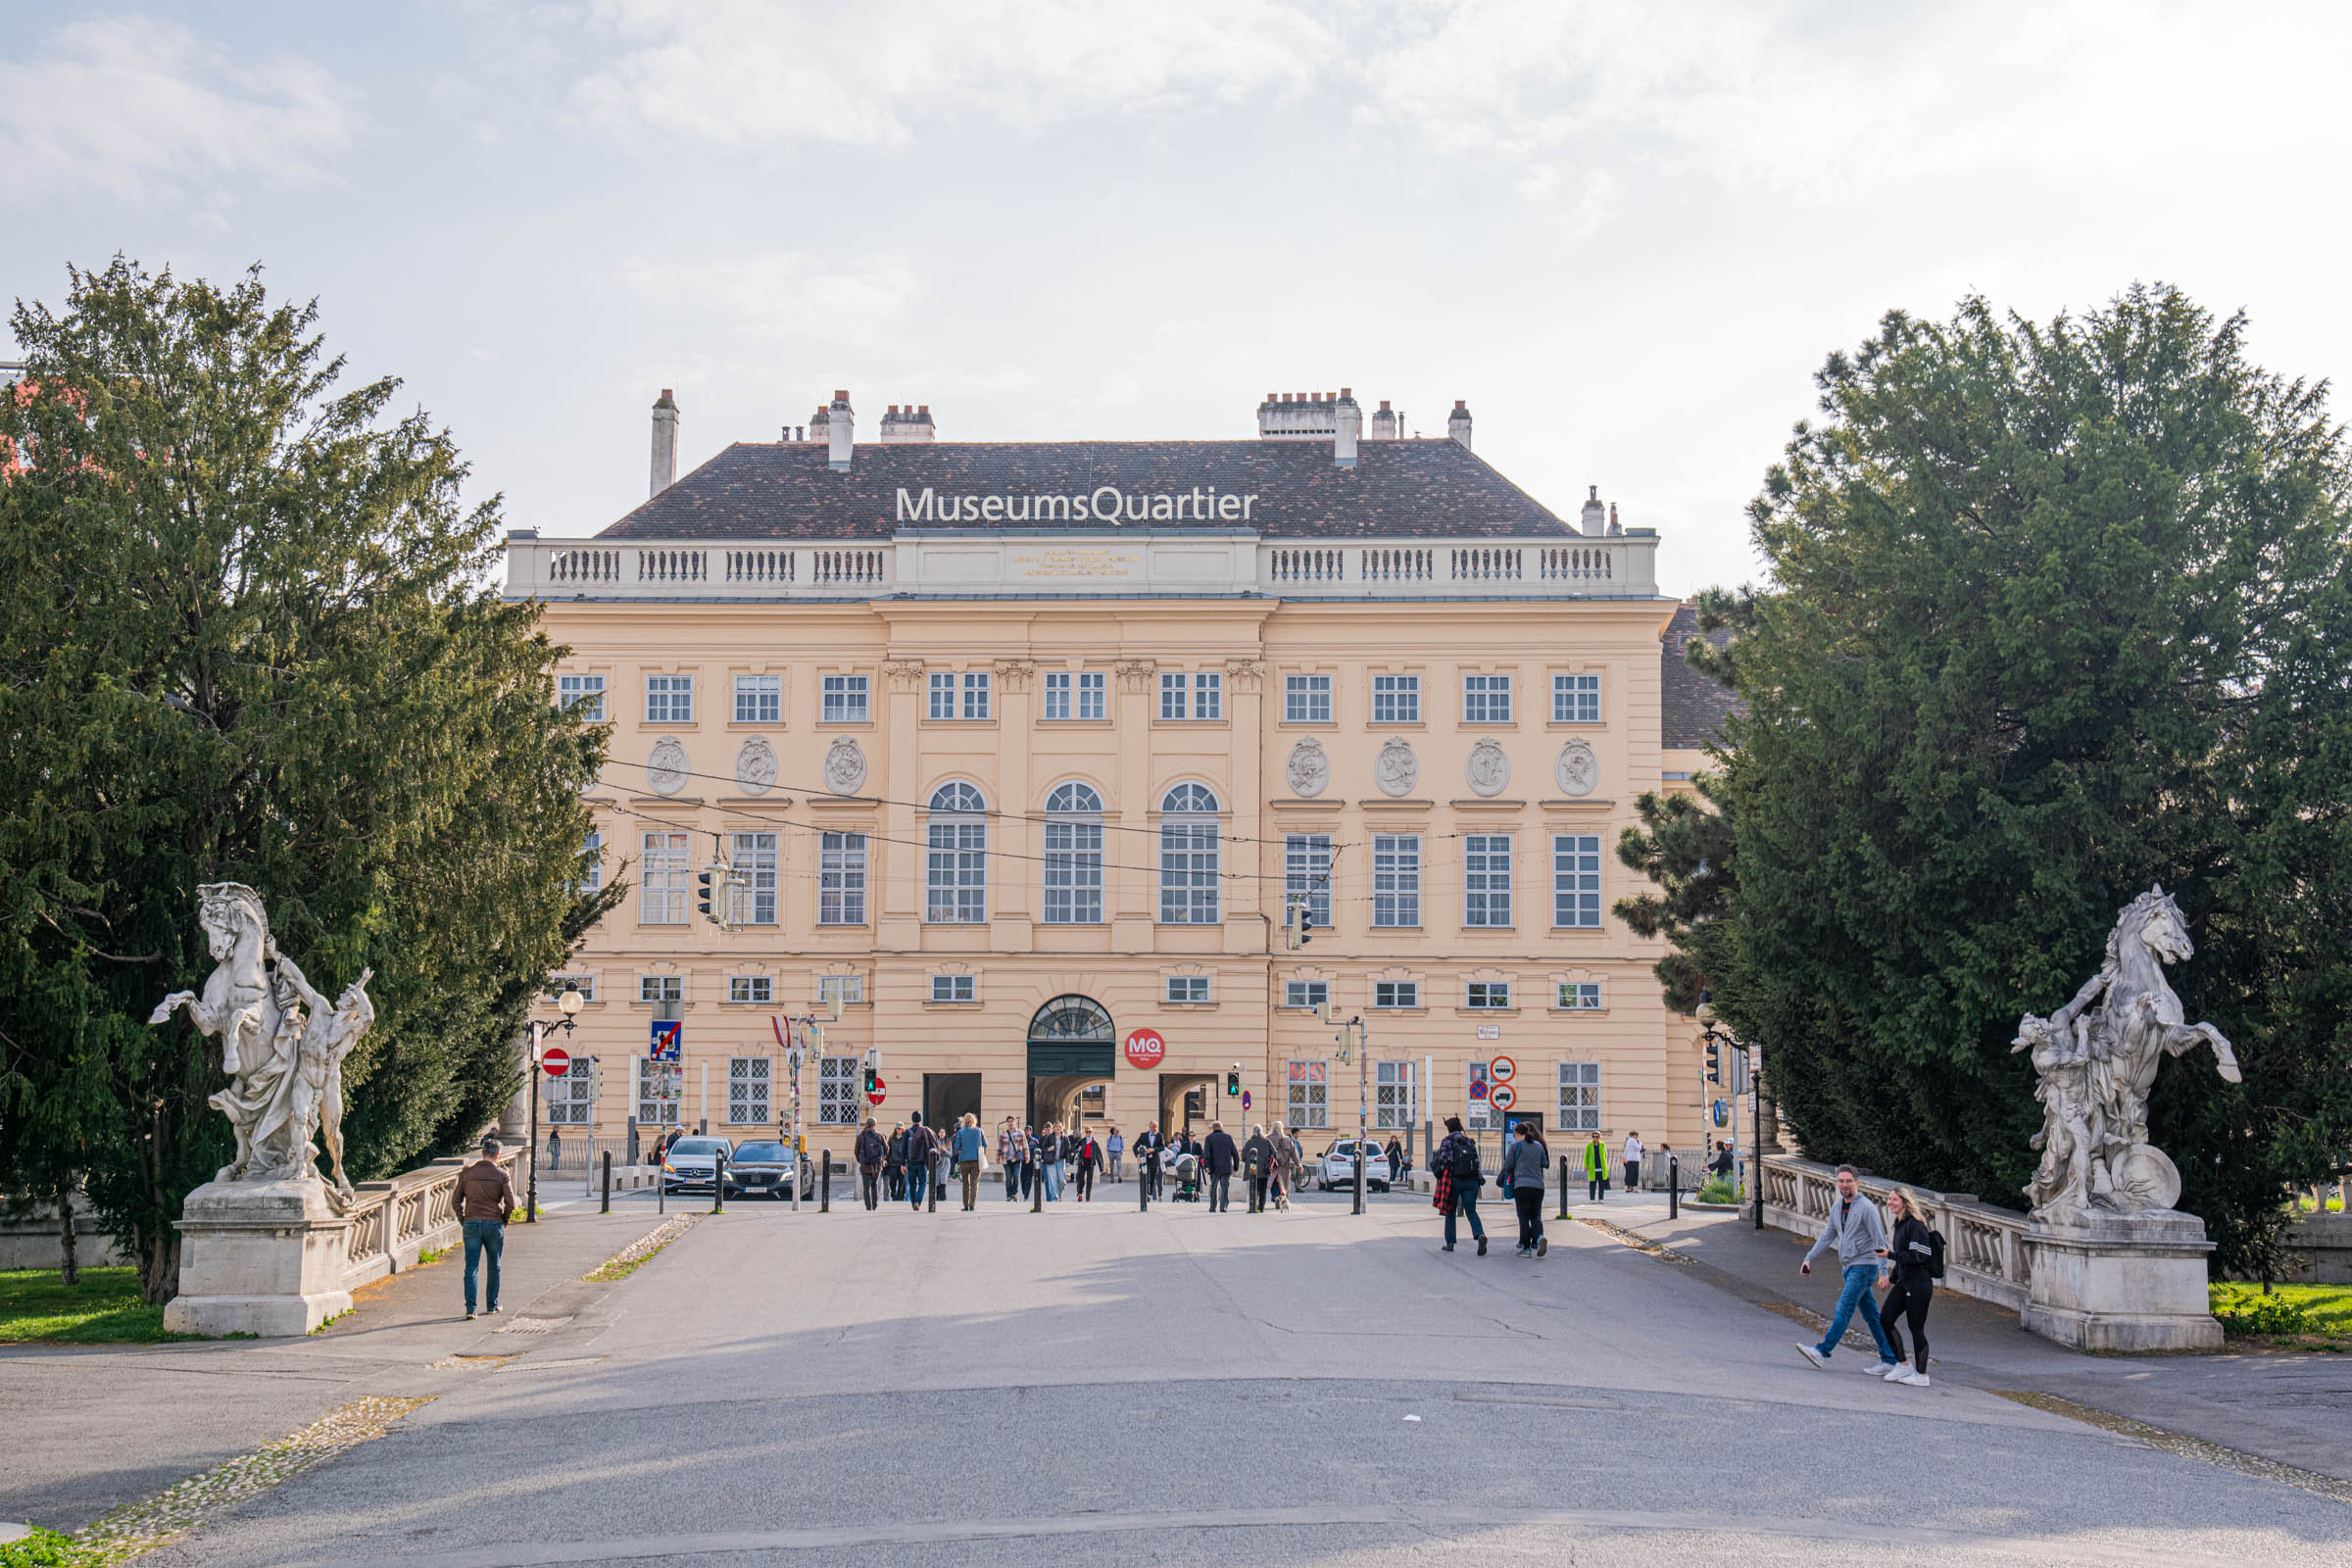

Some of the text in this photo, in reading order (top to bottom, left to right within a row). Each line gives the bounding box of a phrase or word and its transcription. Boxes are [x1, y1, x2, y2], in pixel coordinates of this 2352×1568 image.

[896, 485, 1258, 525] MuseumsQuartier
[1129, 1037, 1161, 1053] MQ
[1289, 1063, 1326, 1082] MQ
